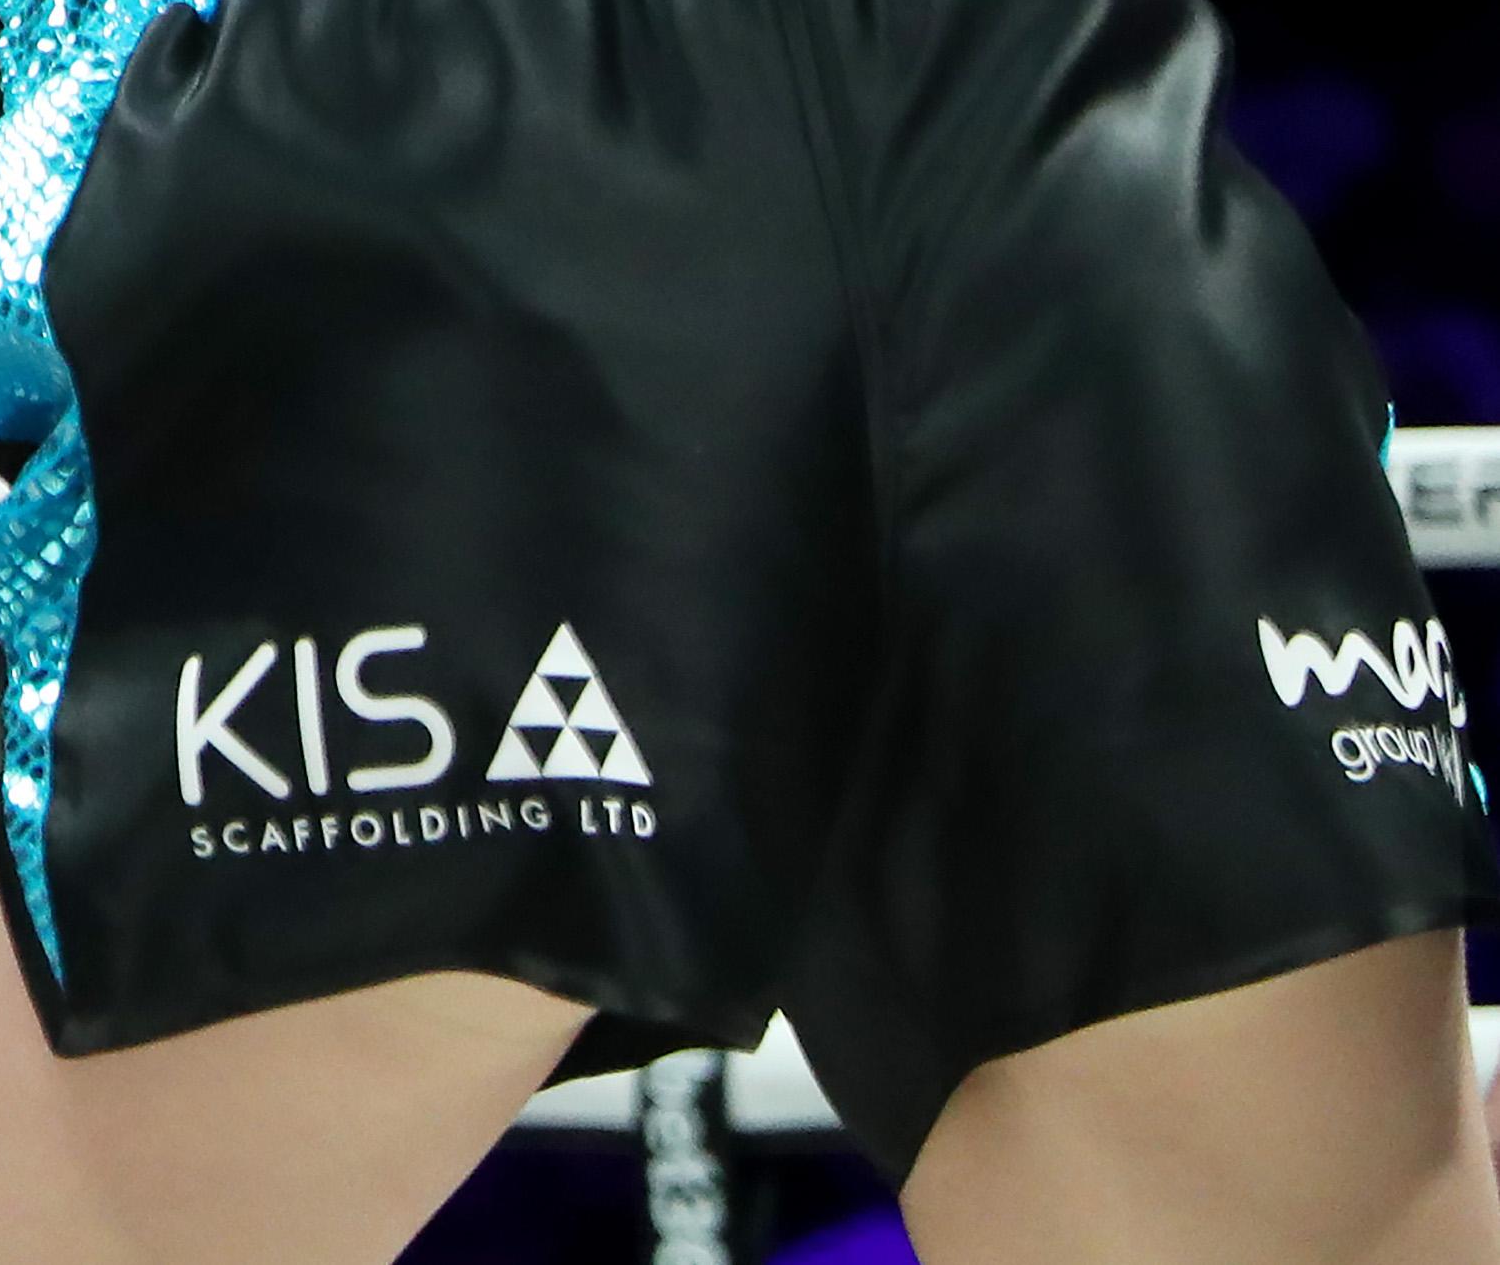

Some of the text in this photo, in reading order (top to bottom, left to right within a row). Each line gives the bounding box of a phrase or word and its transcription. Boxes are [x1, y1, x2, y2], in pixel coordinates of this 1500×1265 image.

[176, 625, 456, 806] KIS
[190, 797, 657, 859] SCAFFOLDING LTD
